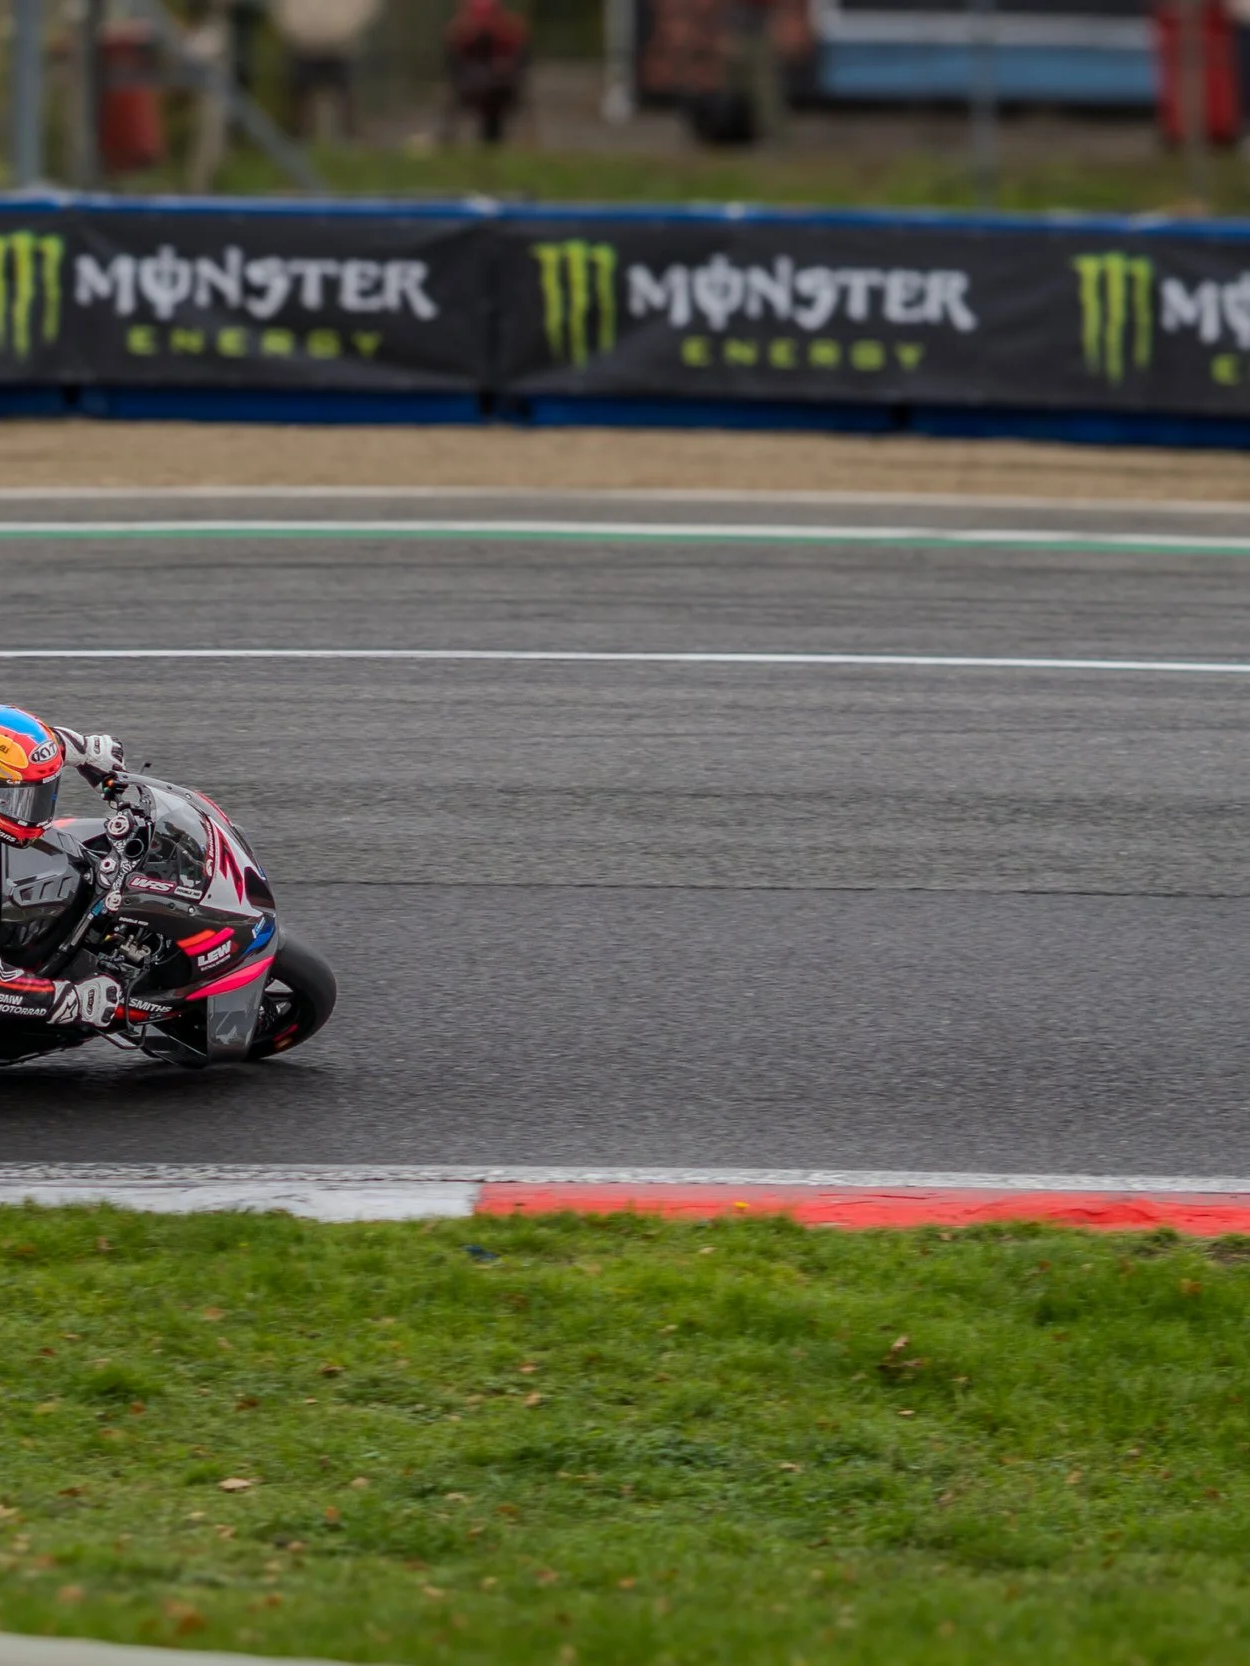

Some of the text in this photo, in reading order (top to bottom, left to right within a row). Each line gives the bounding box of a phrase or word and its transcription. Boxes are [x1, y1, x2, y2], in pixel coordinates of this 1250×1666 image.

[73, 245, 437, 320] MONSTER
[627, 252, 977, 333] MONSTER
[127, 324, 383, 359] ENERGY
[681, 336, 926, 370] ENERGY
[31, 742, 58, 762] KYT
[198, 940, 232, 966] LEW
[128, 998, 172, 1013] SMITHS
